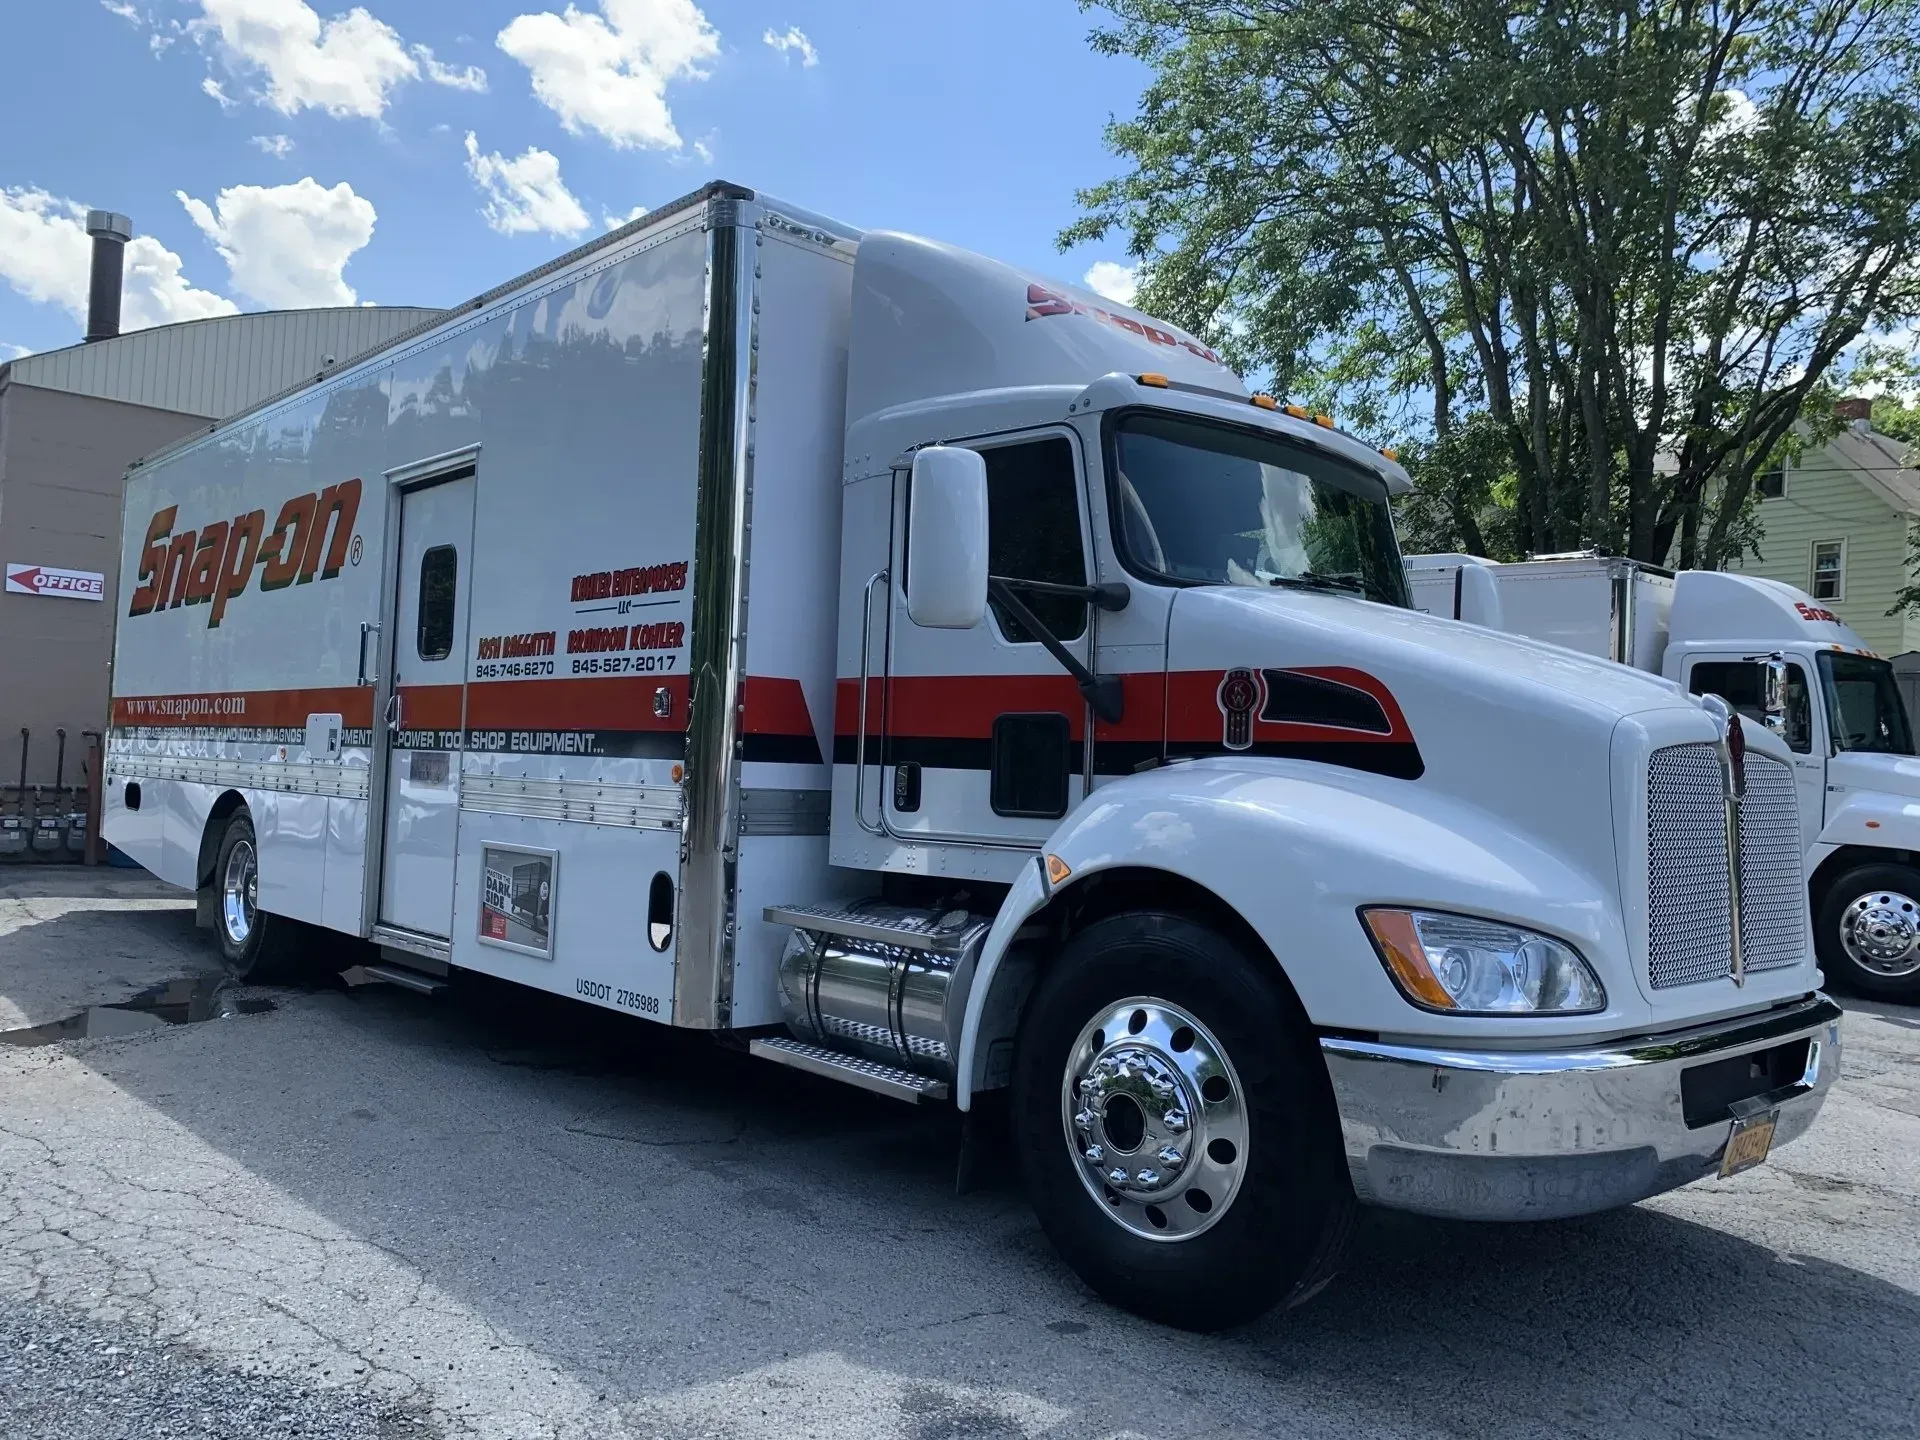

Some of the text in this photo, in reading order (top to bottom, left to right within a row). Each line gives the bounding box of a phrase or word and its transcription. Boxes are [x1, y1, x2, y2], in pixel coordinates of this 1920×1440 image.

[1025, 283, 1224, 365] Snap-o
[128, 478, 362, 629] Snap-on
[32, 573, 102, 592] OFFICE
[571, 560, 688, 602] KOHLER ENTERPRISES
[617, 600, 631, 614] LLC
[477, 635, 502, 660] JOSH
[567, 621, 685, 655] BRANDON KOHLER
[127, 696, 246, 720] www.snapon.com
[218, 728, 237, 740] HAND
[266, 728, 307, 743] DIAGNOST
[341, 729, 372, 745] PMENT
[486, 876, 512, 899] DARK
[486, 890, 505, 910] SIDE
[576, 977, 659, 1014] USDOT 2785988
